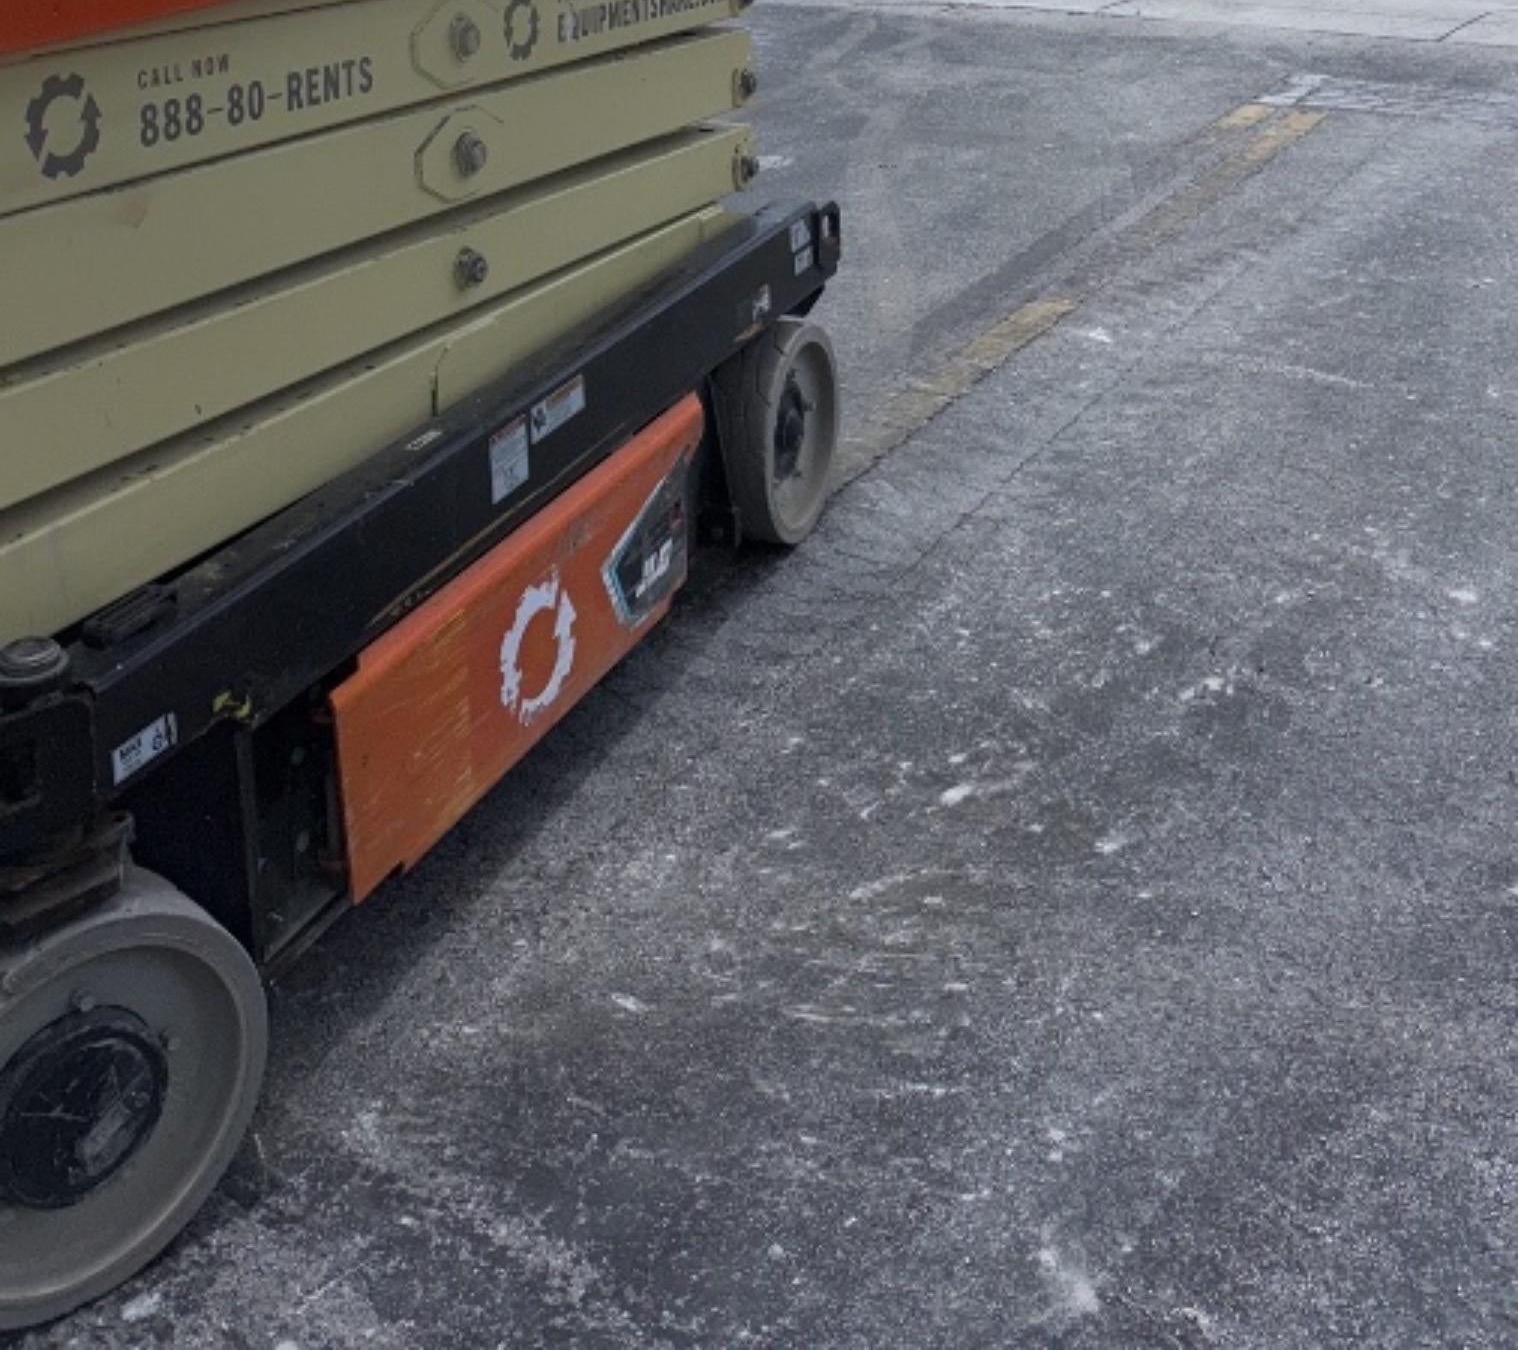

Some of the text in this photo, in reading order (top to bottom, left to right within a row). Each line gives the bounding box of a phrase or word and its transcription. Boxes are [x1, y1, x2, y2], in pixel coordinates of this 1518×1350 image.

[137, 54, 229, 90] CALL NOW
[140, 57, 373, 147] 888-80-RENTS
